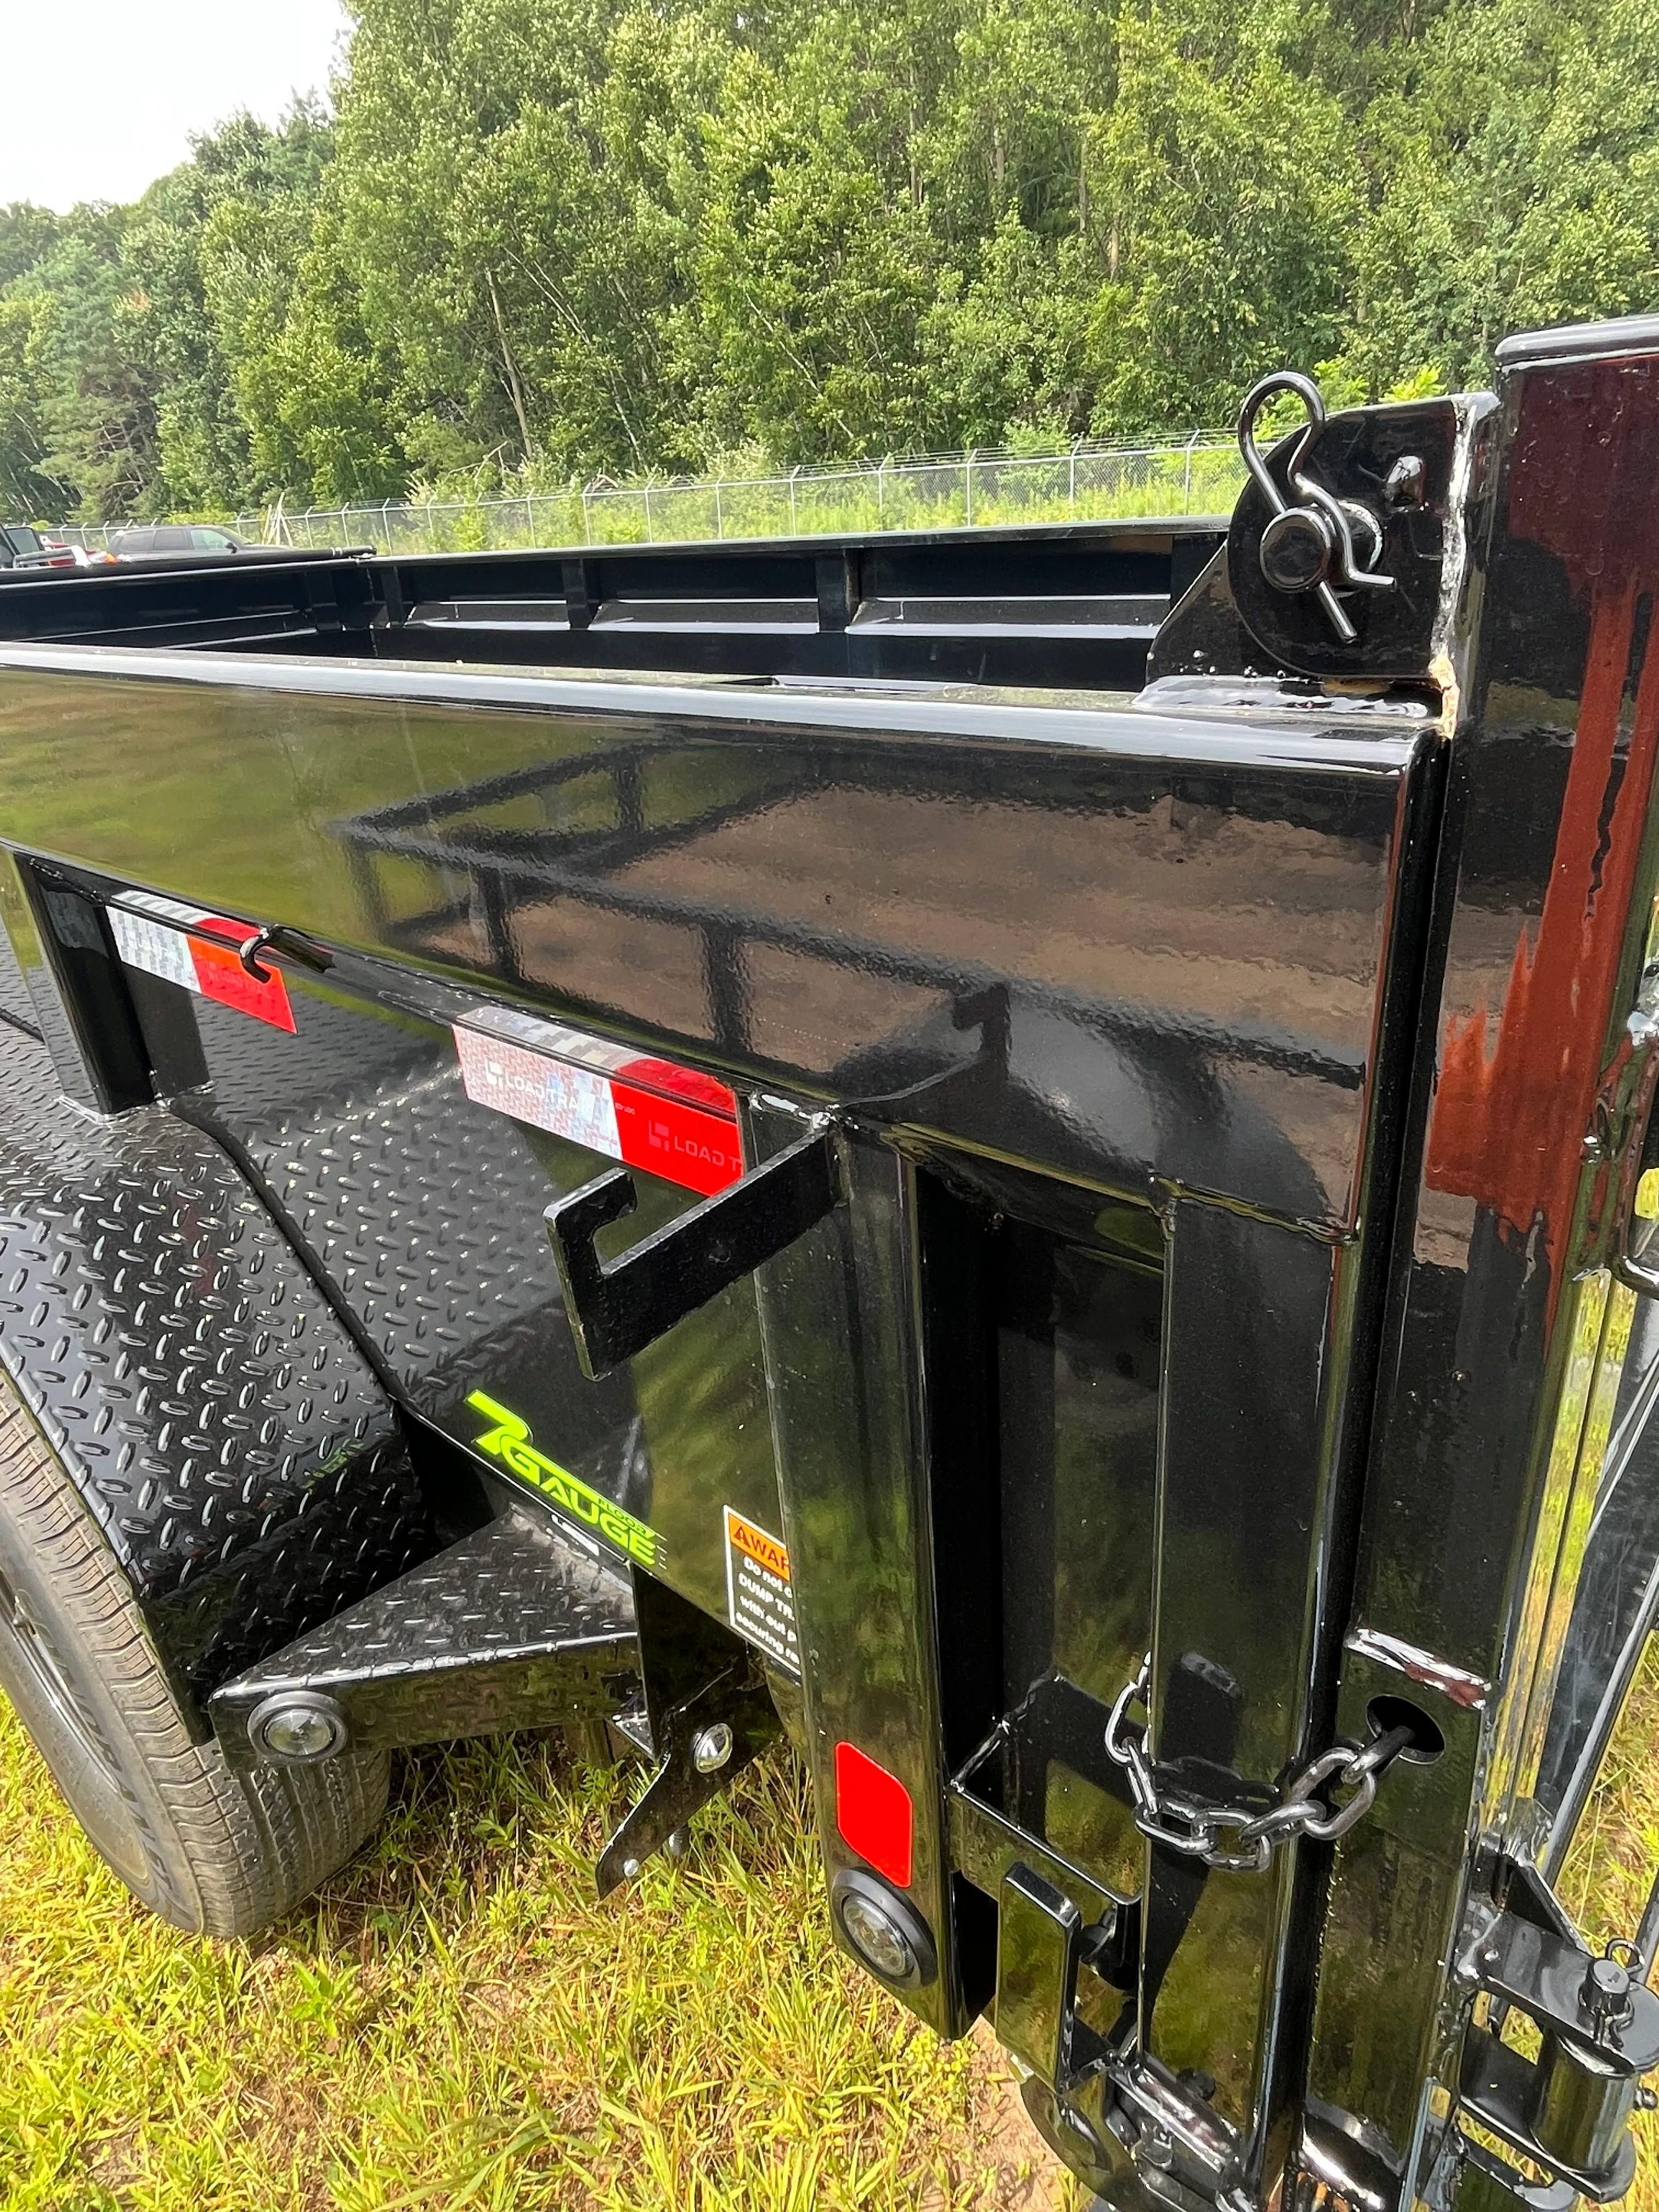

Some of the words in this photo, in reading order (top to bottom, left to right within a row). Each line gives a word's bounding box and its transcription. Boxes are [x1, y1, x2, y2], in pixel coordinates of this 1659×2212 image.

[505, 1068, 545, 1098] LOAD
[674, 1135, 725, 1166] LOAD
[465, 1389, 529, 1455] 7
[500, 1434, 657, 1565] GAUGE
[599, 1498, 646, 1536] FLOOR
[739, 1572, 774, 1603] DUMP
[763, 1571, 783, 1592] not
[740, 1595, 765, 1620] with
[766, 1615, 786, 1635] out
[735, 1612, 785, 1655] securing
